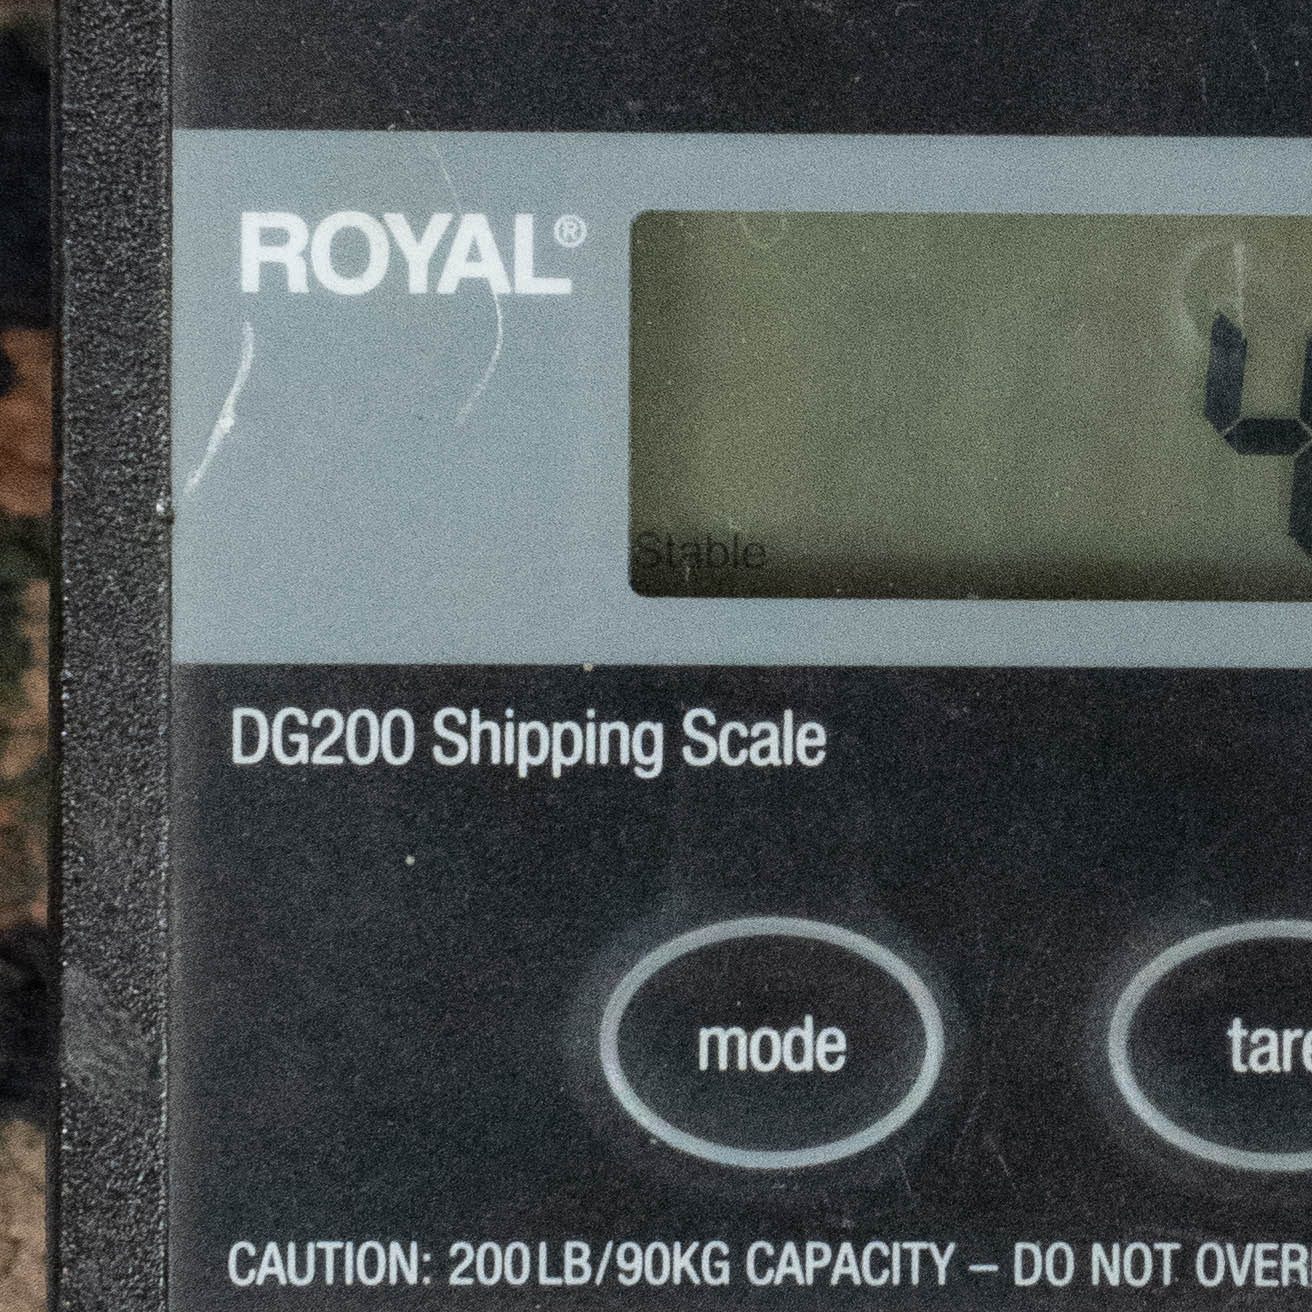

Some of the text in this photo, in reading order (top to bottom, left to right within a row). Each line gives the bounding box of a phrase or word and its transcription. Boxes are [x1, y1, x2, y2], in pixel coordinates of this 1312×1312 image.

[636, 531, 768, 570] Stable
[230, 709, 828, 780] DG200 Shipping Scale
[697, 1014, 847, 1074] mode
[226, 1241, 431, 1286] CAUTION:
[746, 1241, 956, 1287] CAPACITY
[1013, 1242, 1074, 1287] DO
[1091, 1242, 1181, 1287] NOT
